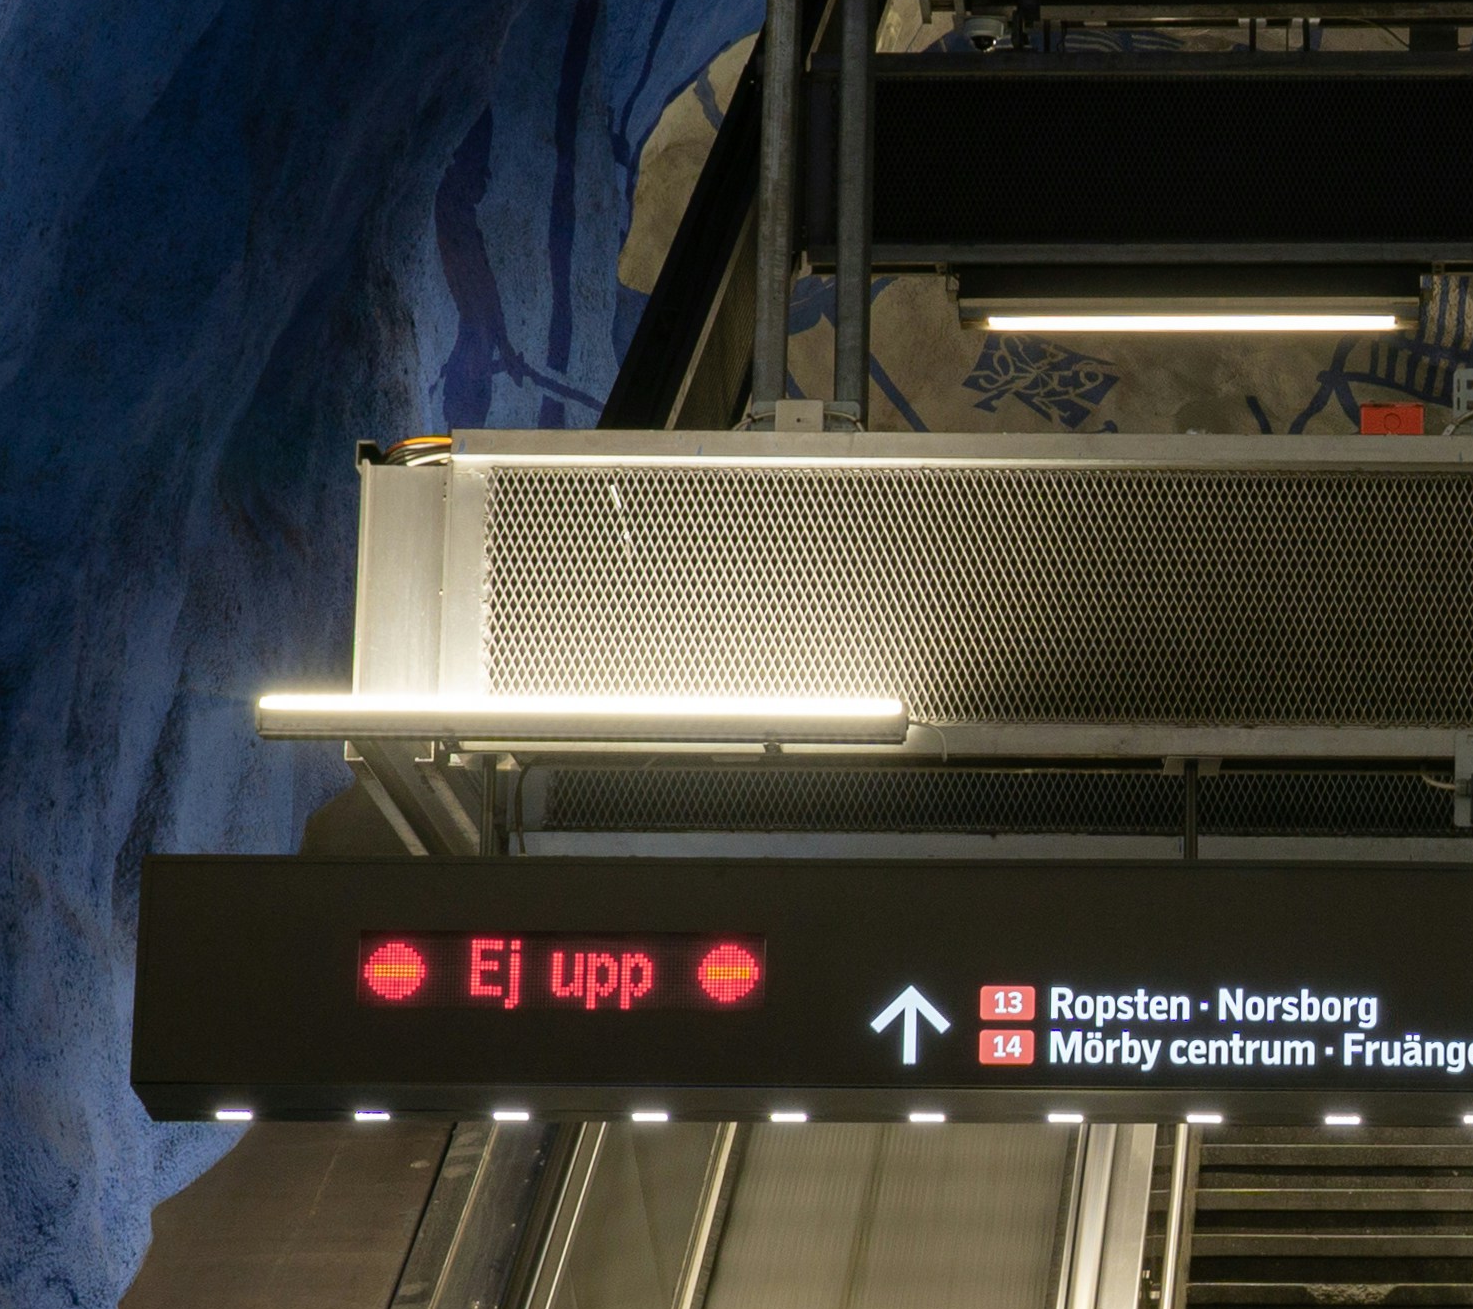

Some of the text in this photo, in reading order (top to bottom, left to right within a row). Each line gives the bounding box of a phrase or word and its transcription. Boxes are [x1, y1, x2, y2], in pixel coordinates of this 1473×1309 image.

[469, 938, 655, 1010] Ej upp
[995, 987, 1378, 1029] 13 Ropsten Norsborg
[994, 1035, 1023, 1058] 14
[1049, 1030, 1162, 1072] Mörby
[1169, 1032, 1316, 1066] centrum
